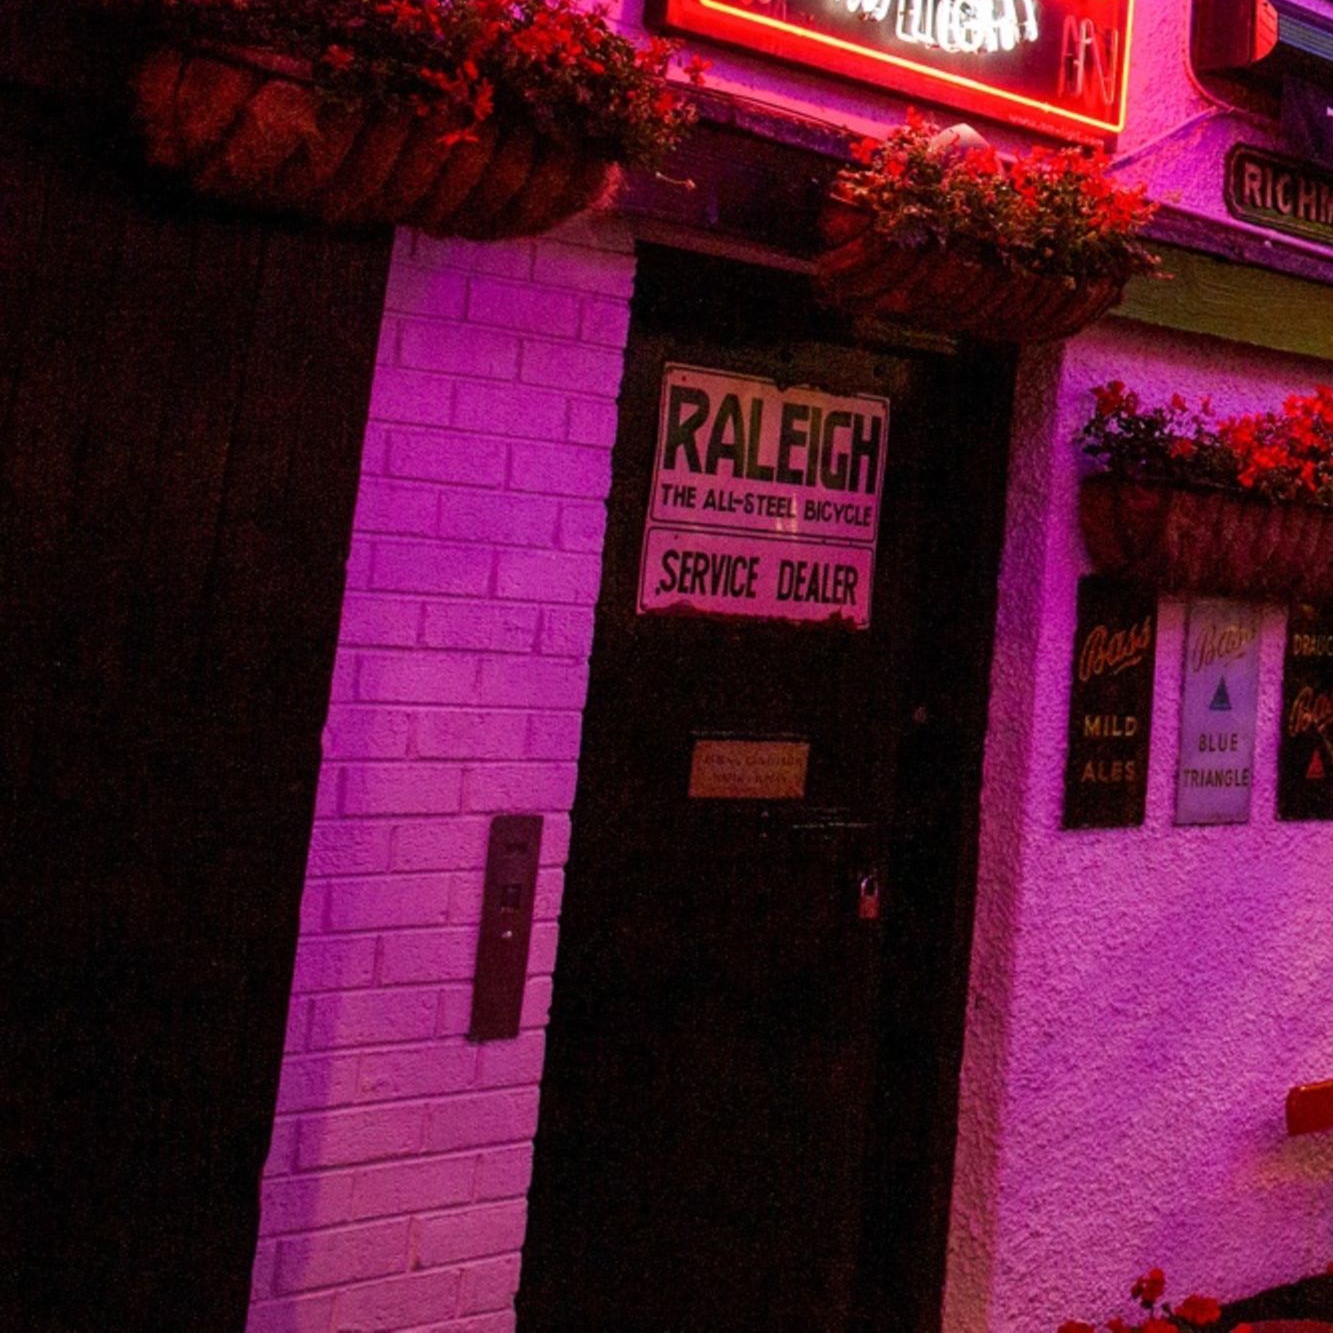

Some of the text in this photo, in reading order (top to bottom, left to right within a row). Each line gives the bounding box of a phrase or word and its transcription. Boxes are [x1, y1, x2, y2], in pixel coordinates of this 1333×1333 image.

[665, 384, 881, 494] RALEIGH
[660, 482, 873, 528] THE ALL-STEEL BICYCLE
[658, 550, 858, 606] SERVICE DEALER
[1084, 715, 1138, 737] MILD
[1199, 733, 1238, 752] BLUE
[1081, 760, 1136, 783] ALES
[1183, 768, 1250, 788] TRIANGLE
